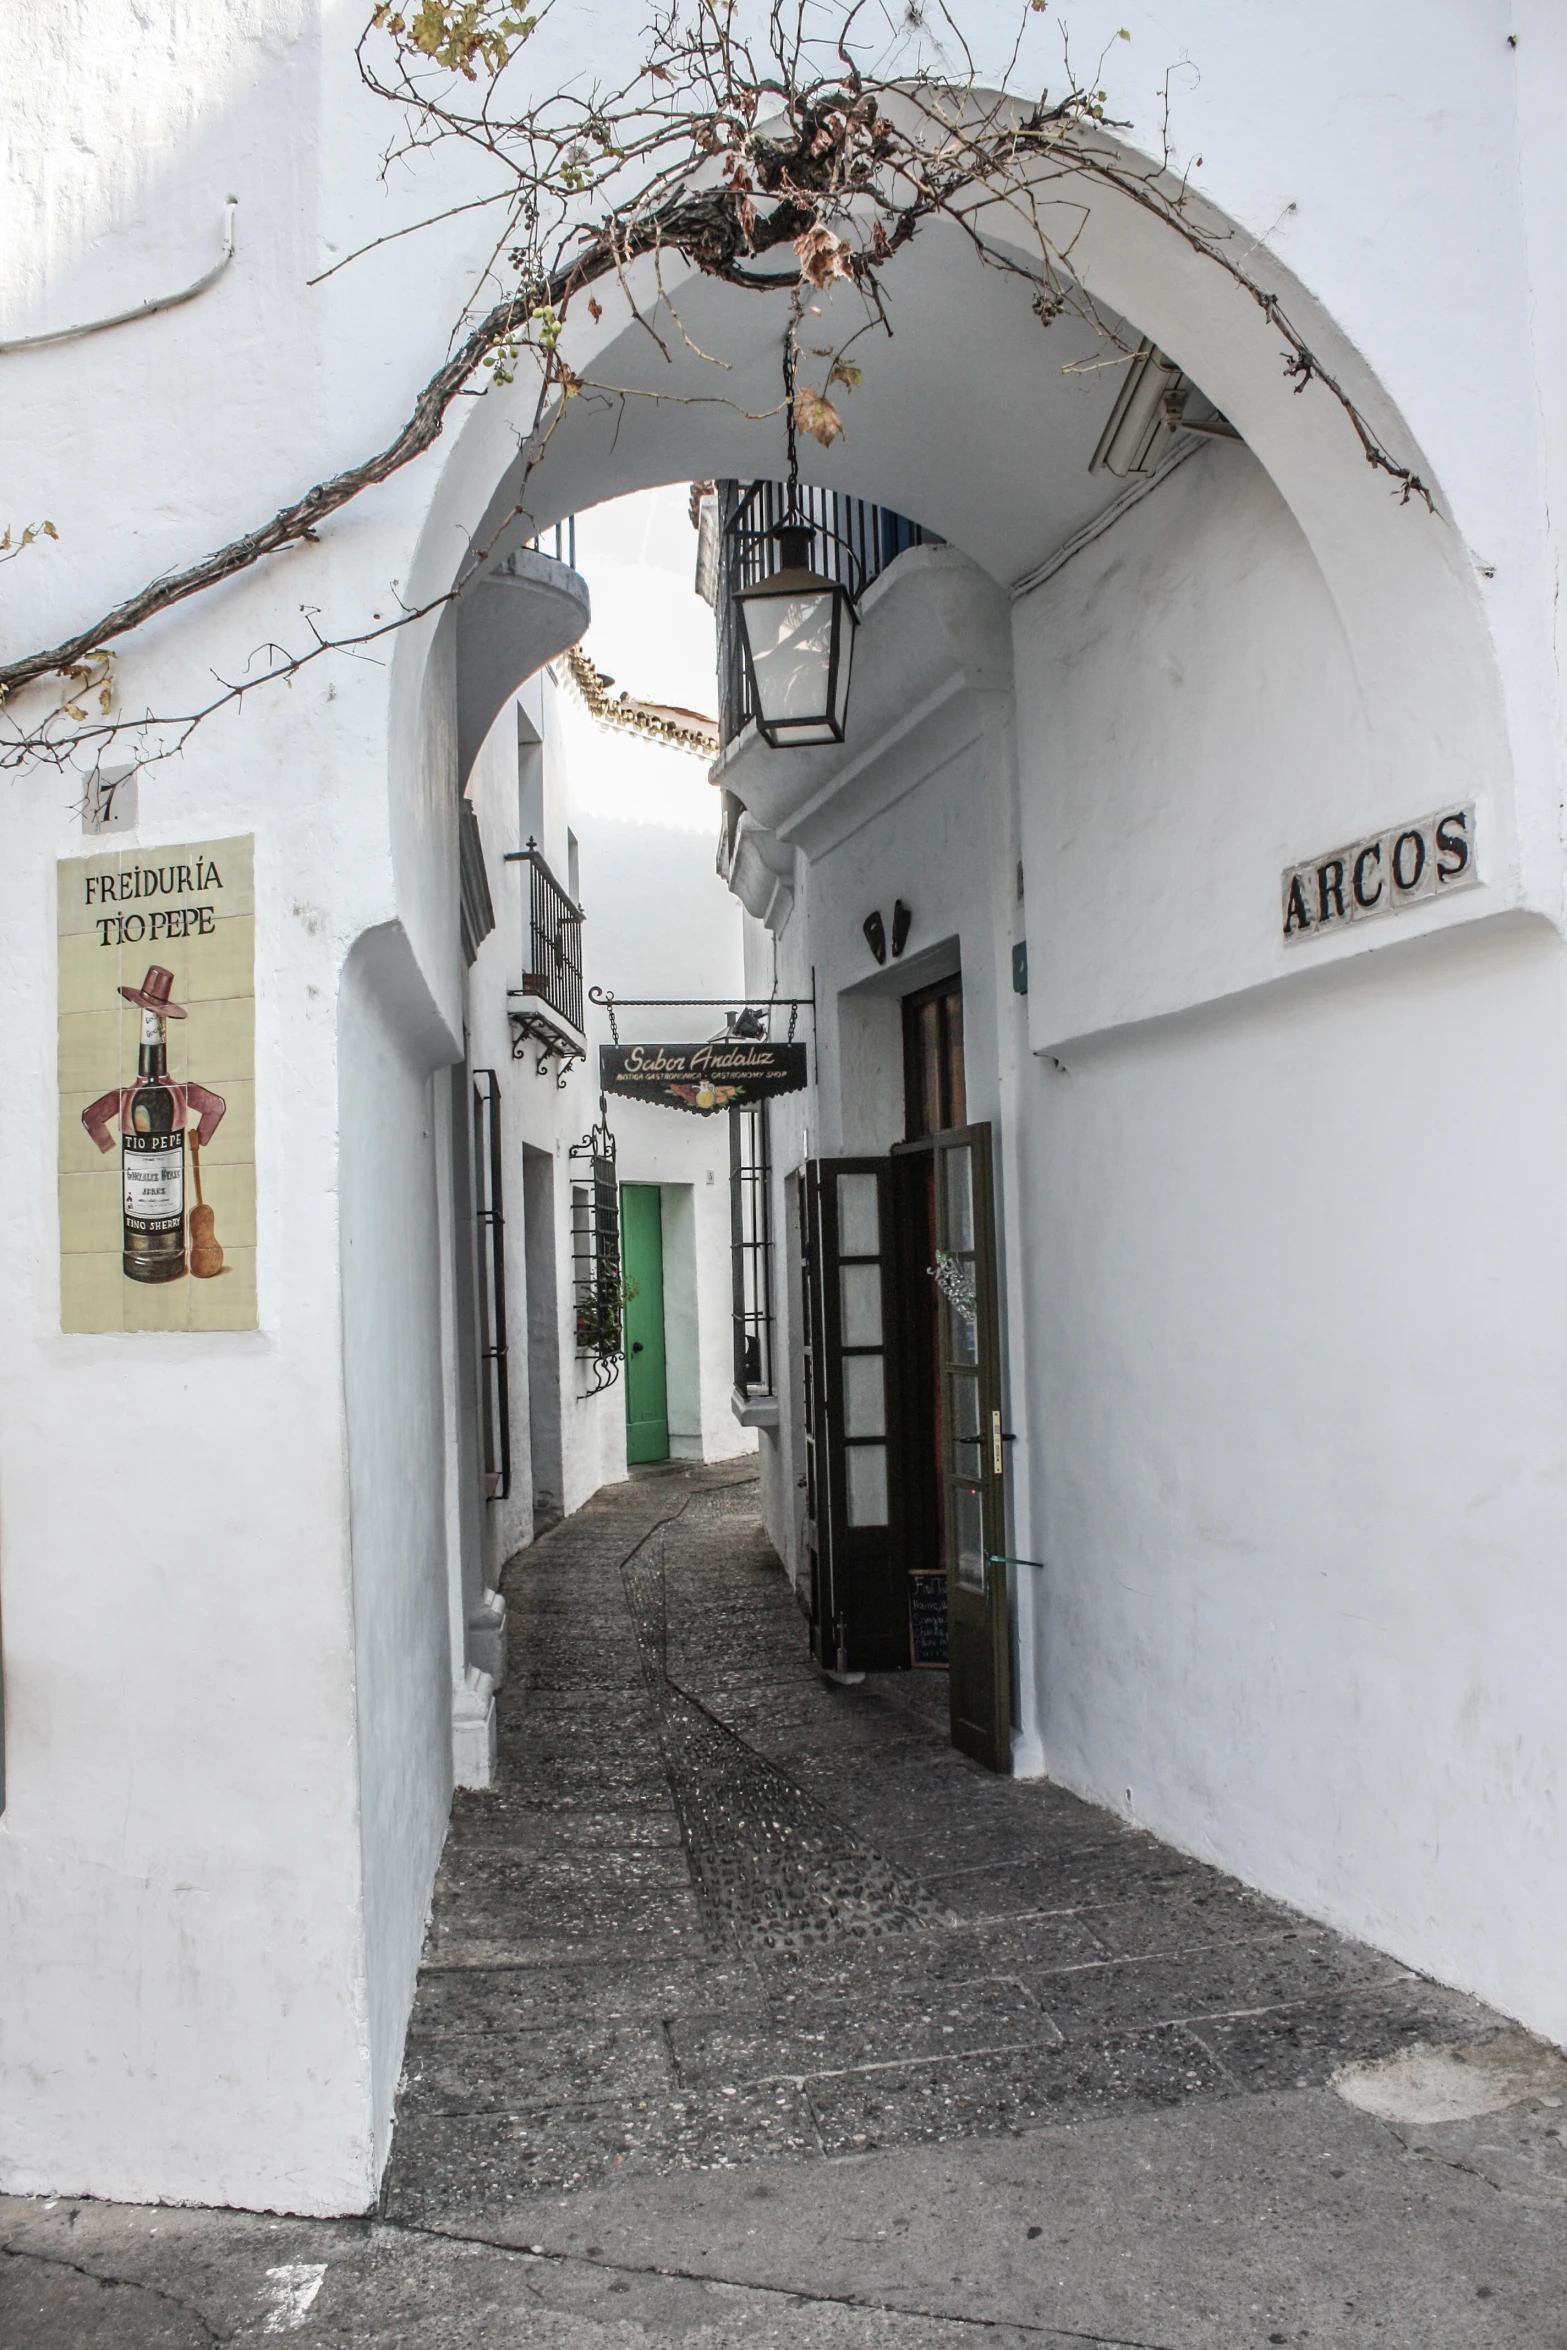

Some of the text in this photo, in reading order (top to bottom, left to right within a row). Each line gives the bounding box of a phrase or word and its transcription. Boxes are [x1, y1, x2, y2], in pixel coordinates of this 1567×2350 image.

[85, 855, 224, 905] FREIDURÍA
[1283, 811, 1468, 933] ARCOS
[149, 906, 216, 942] PEPE
[624, 1045, 775, 1072] Sabor Andaluz
[711, 1071, 764, 1080] GASTRONOMY
[765, 1070, 788, 1079] SHOP
[125, 1133, 182, 1150] TIO PEPE
[126, 1217, 181, 1230] FINO SHERRY
